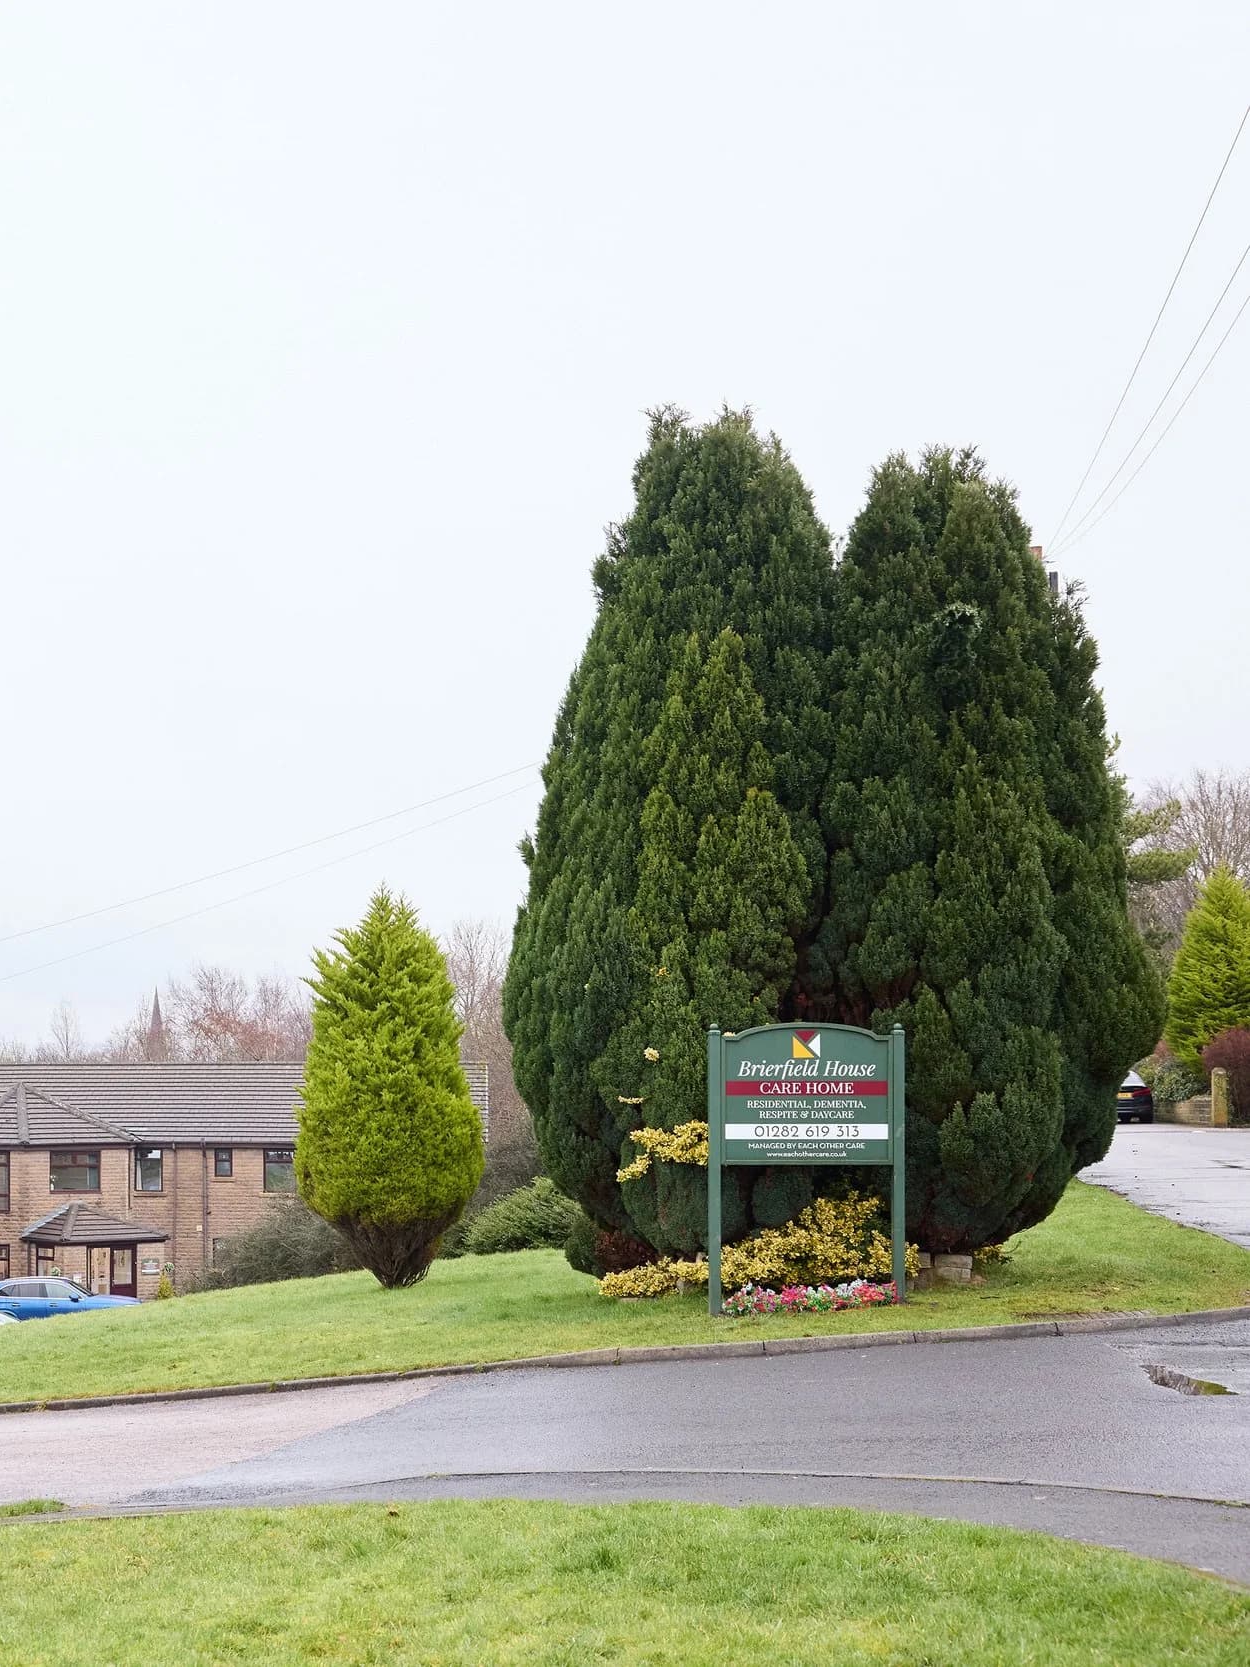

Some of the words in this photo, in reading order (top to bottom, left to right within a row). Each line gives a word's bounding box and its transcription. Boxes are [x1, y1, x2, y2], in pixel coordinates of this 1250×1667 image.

[738, 1060, 819, 1080] Brierfield
[823, 1060, 876, 1077] House
[759, 1082, 801, 1095] CARE
[805, 1082, 854, 1095] HOME
[747, 1100, 812, 1110] RESIDENTIAL,
[813, 1100, 867, 1109] DEMENTIA,
[759, 1111, 798, 1119] RESPITE
[800, 1111, 809, 1119] &
[811, 1111, 855, 1119] DAYCARE
[754, 1125, 799, 1138] 01282
[805, 1125, 830, 1138] 619
[836, 1125, 860, 1138] 313
[748, 1142, 786, 1150] MANAGED
[787, 1142, 797, 1150] BY
[798, 1142, 819, 1150] EACH
[819, 1142, 844, 1150] OTHER
[845, 1142, 866, 1150] CARE
